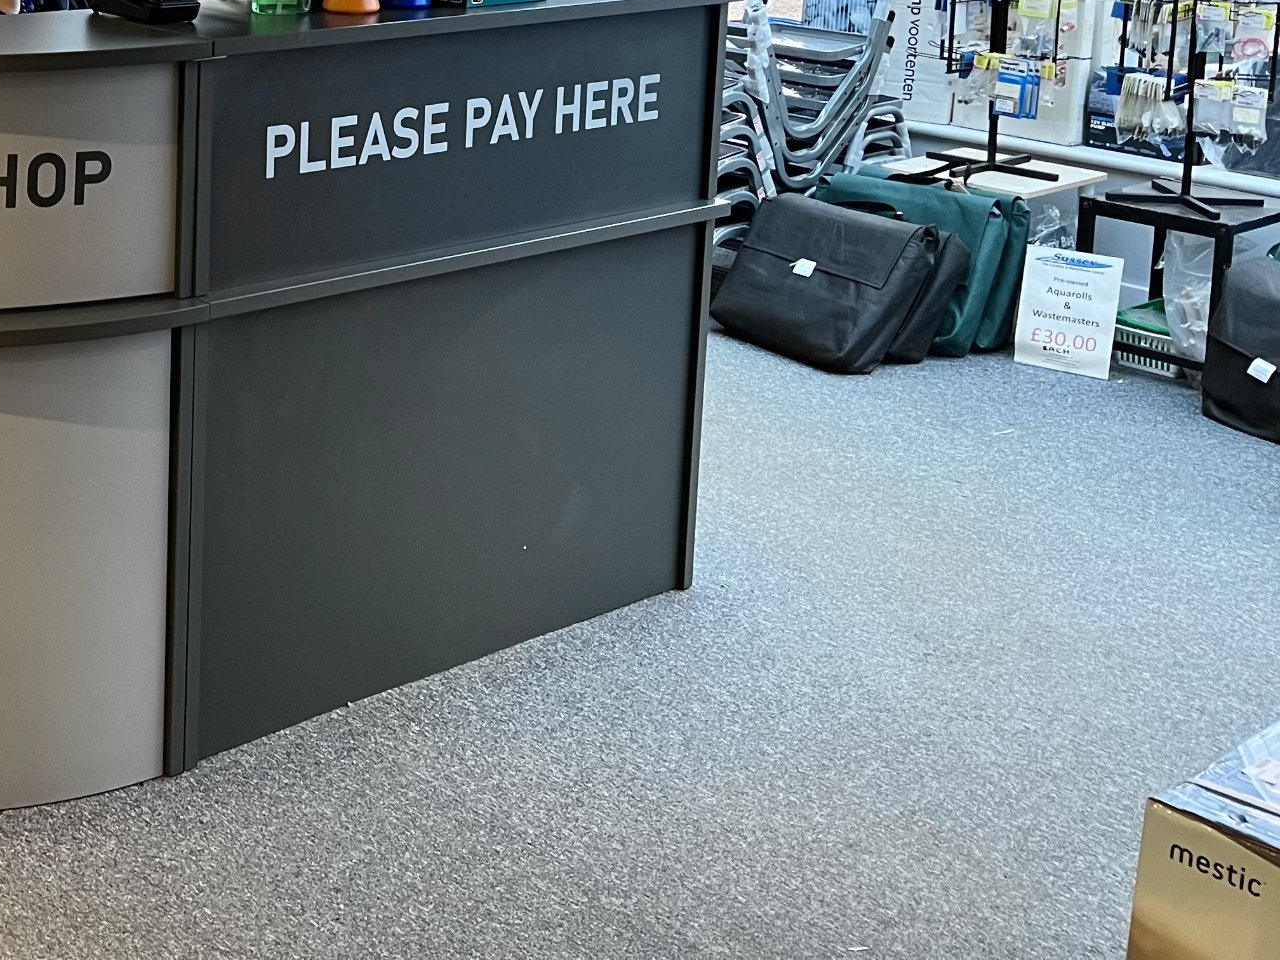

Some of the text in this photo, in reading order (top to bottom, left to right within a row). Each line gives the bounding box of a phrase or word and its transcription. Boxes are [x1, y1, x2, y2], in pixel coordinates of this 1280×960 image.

[902, 19, 921, 101] voortenten
[265, 73, 661, 180] PLEASE PAY HERE
[1054, 253, 1097, 266] Sussex
[1053, 277, 1089, 287] Pre-owned
[1046, 286, 1092, 301] Aquarolls
[1063, 302, 1071, 310] &
[1032, 309, 1100, 328] Wastemasters
[1030, 327, 1097, 352] £30.00
[1043, 345, 1070, 355] EACH
[1169, 843, 1262, 897] mestic
